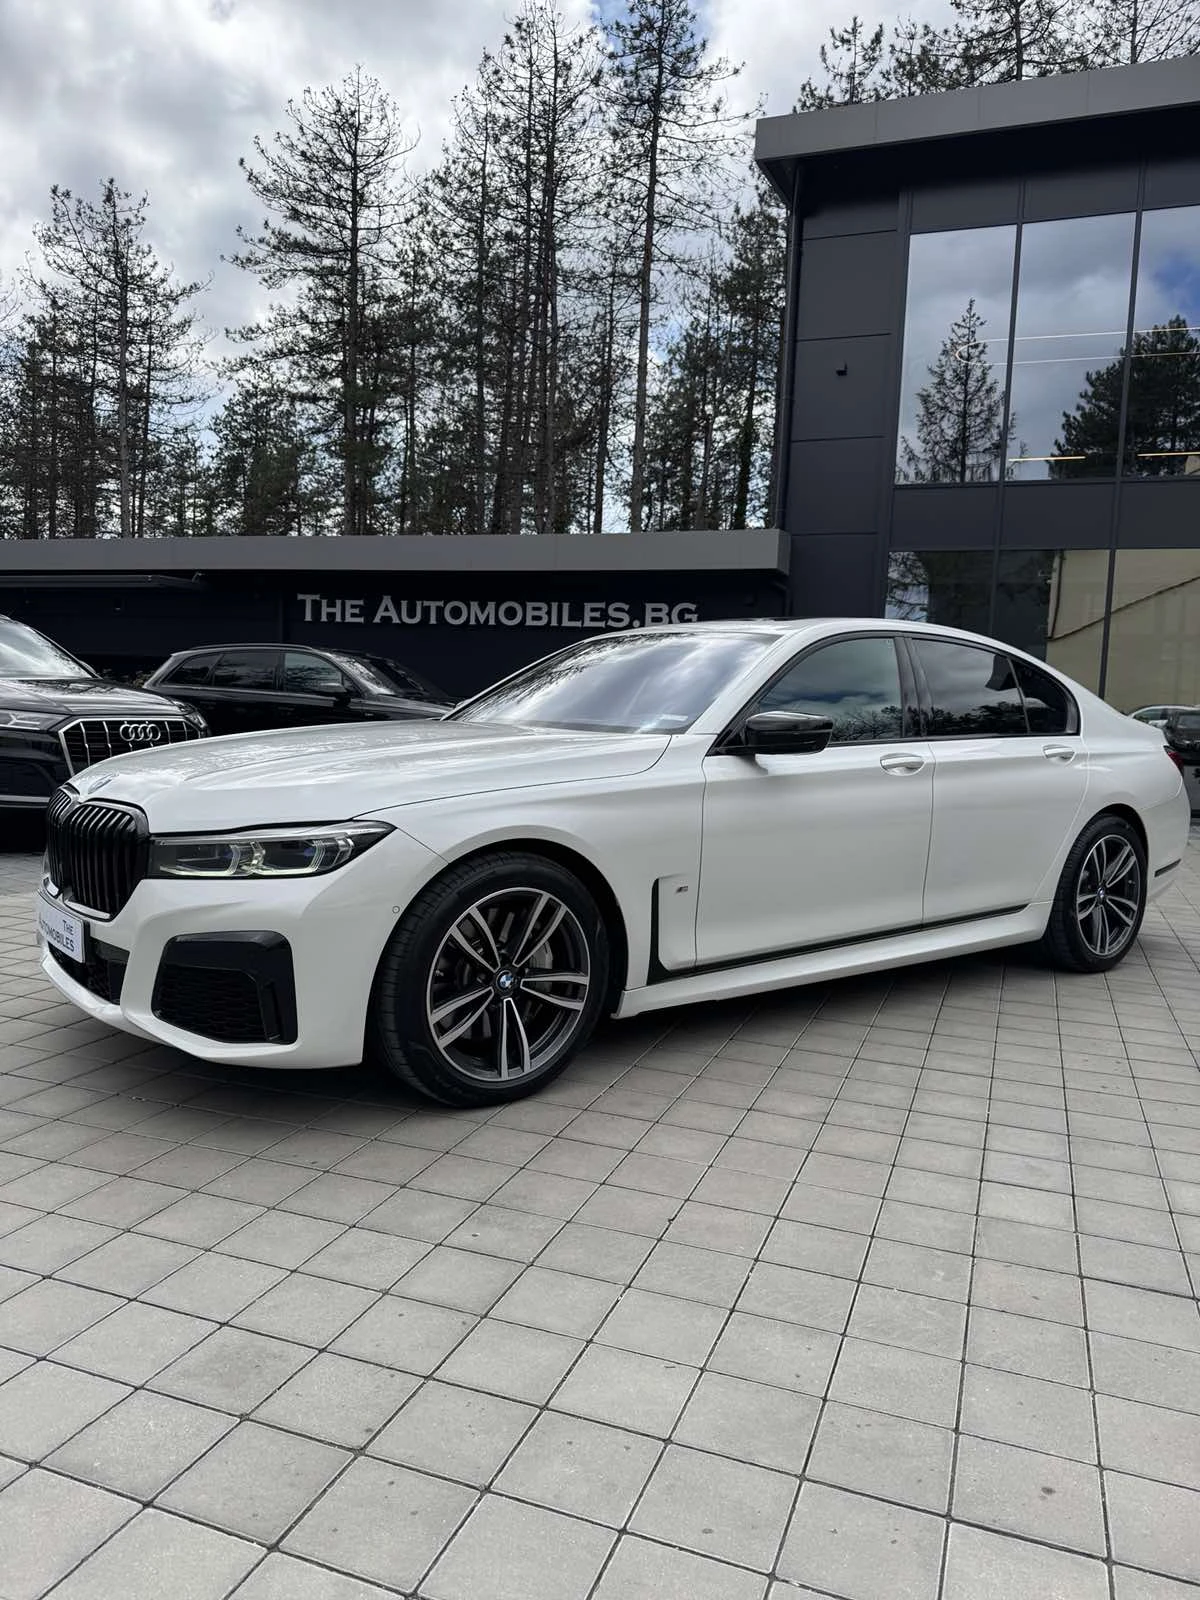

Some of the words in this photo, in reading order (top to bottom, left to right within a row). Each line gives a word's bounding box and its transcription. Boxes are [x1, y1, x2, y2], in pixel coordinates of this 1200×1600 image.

[297, 593, 364, 624] THE
[373, 595, 699, 628] AUTOMOBILES.BG
[63, 919, 74, 936] THE
